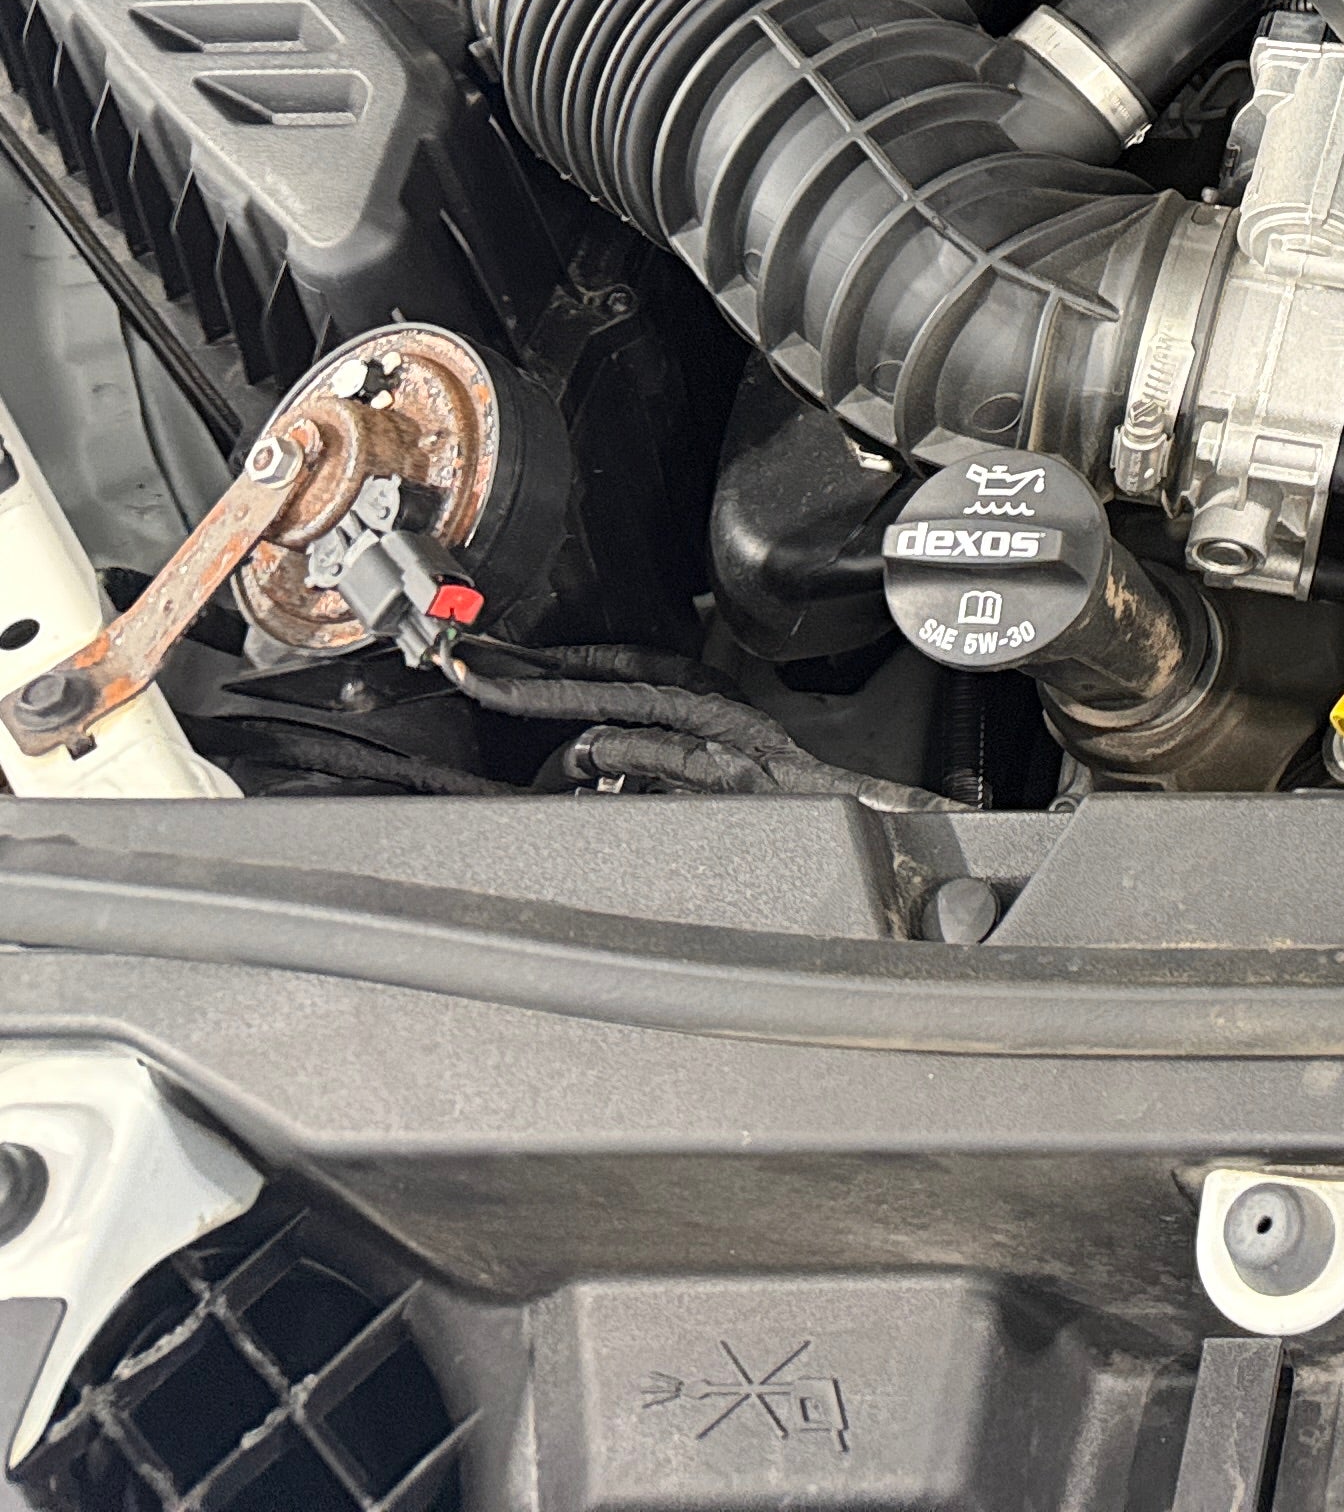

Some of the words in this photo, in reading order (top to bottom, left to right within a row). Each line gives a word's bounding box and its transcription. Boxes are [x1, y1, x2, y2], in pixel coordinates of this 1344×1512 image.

[896, 521, 1040, 558] dexos
[918, 618, 959, 651] SAE
[963, 620, 1036, 655] 5W-30
